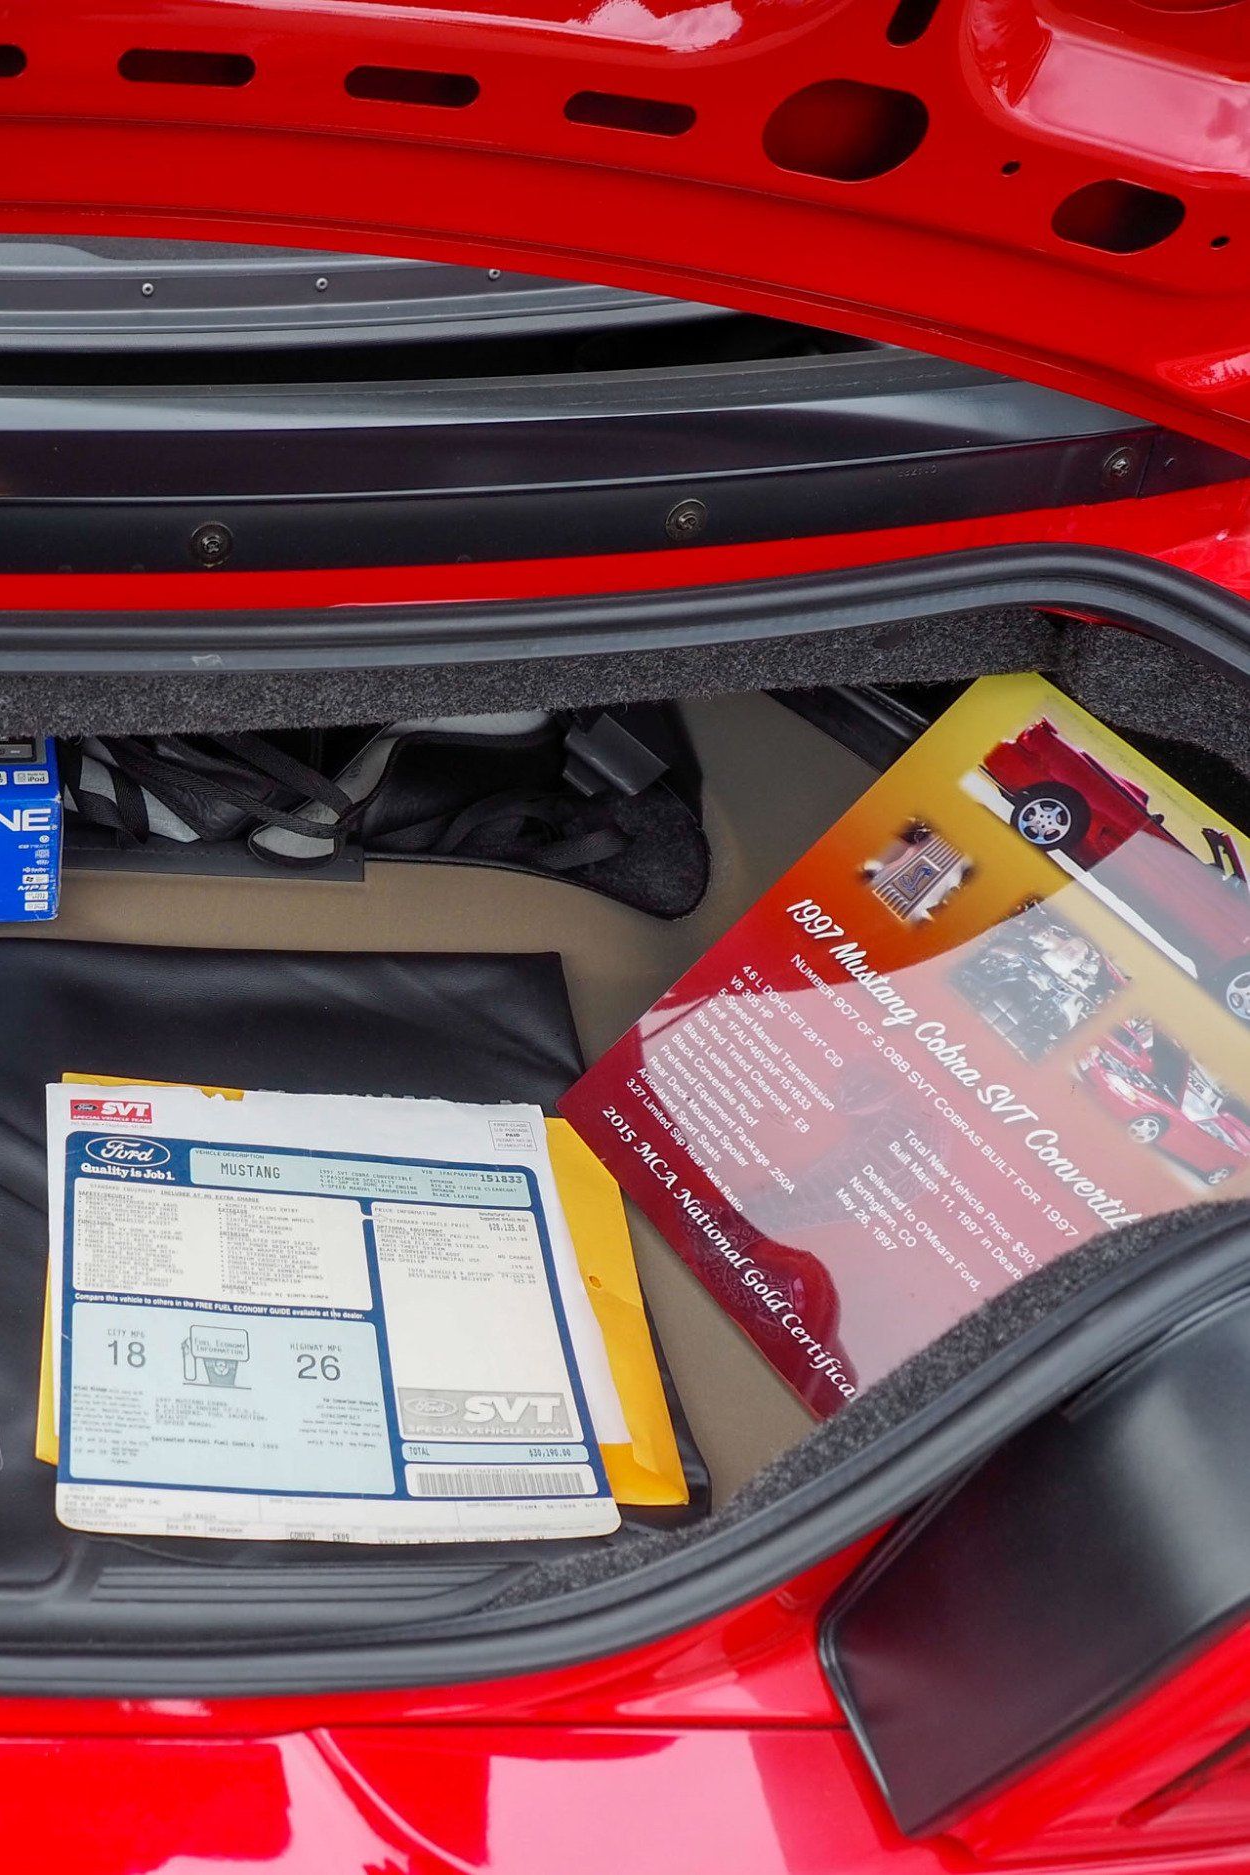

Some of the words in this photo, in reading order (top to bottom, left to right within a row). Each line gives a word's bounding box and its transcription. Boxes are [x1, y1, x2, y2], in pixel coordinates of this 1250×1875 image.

[706, 998, 728, 1021] Vin#
[730, 974, 745, 991] V8
[741, 988, 762, 1008] 305
[758, 1004, 774, 1019] HP
[742, 965, 759, 981] 4.6
[754, 977, 764, 989] L
[761, 983, 791, 1014] DOHC
[787, 1010, 807, 1030] EFI
[824, 1048, 844, 1068] CID
[785, 899, 845, 940] 1997
[828, 942, 913, 1025] Mustang
[914, 1021, 982, 1088] Cobra
[976, 1084, 1039, 1124] SVT
[671, 1032, 695, 1060] Black
[693, 1057, 737, 1106] Convertible
[735, 1102, 760, 1128] Roof
[682, 1021, 708, 1050] Black
[704, 1045, 737, 1080] Leather
[734, 1077, 764, 1110] Interior
[694, 1009, 710, 1028] Rio
[707, 1024, 729, 1046] Red
[726, 1041, 754, 1073] Tinted
[750, 1069, 792, 1115] Clearcoat
[793, 1116, 811, 1134] E8
[717, 987, 755, 1026] 5-Speed
[750, 1021, 784, 1055] Manual
[780, 1051, 835, 1112] Transmission
[100, 1102, 150, 1118] SVT
[636, 1067, 679, 1113] Articulated
[676, 1110, 700, 1137] Sport
[696, 1133, 722, 1163] Seats
[648, 1055, 670, 1078] Rear
[666, 1075, 689, 1101] Deck
[686, 1098, 724, 1138] Mounted
[719, 1134, 750, 1168] Spoiler
[660, 1044, 699, 1086] Preferred
[693, 1081, 737, 1130] Equipment
[732, 1125, 771, 1168] Package
[790, 953, 836, 999] NUMBER
[832, 996, 860, 1020] 907
[906, 1070, 938, 1098] SVT
[933, 1096, 984, 1147] COBRAS
[980, 1144, 1018, 1178] BUILT
[1012, 1176, 1042, 1205] FOR
[1041, 1203, 1079, 1237] 1997
[80, 1162, 129, 1179] Quality
[129, 1169, 142, 1178] is
[143, 1169, 165, 1180] Job
[100, 1140, 154, 1162] Ford
[220, 1162, 281, 1179] MUSTANG
[626, 1077, 647, 1098] 3.27
[642, 1096, 674, 1130] Limited
[669, 1127, 686, 1147] Slip
[683, 1143, 706, 1168] Rear
[702, 1166, 723, 1188] Axle
[720, 1184, 744, 1212] Ratio
[480, 1174, 523, 1184] 151833
[602, 1105, 638, 1143] 2015
[633, 1141, 679, 1190] MCA
[673, 1188, 755, 1270] National
[740, 1269, 793, 1314] Gold
[848, 1175, 898, 1232] Northglenn,
[898, 1228, 917, 1248] CO
[888, 1140, 912, 1166] Built
[908, 1161, 940, 1195] March
[940, 1194, 956, 1213] 11,
[956, 1210, 984, 1236] 1997
[980, 1235, 993, 1250] in
[904, 1128, 932, 1158] Total
[925, 1153, 952, 1179] New
[949, 1175, 985, 1215] Vehicle
[983, 1211, 1014, 1244] Price:
[835, 1187, 858, 1211] May
[854, 1208, 872, 1229] 26,
[872, 1226, 898, 1251] 1997
[861, 1164, 909, 1211] Delivered
[903, 1208, 916, 1222] to
[915, 1220, 956, 1265] O'Meara
[954, 1261, 981, 1292] Ford,
[74, 1292, 104, 1302] Compare
[106, 1294, 118, 1302] this
[183, 1300, 194, 1308] the
[194, 1301, 213, 1310] FREE
[214, 1303, 232, 1311] FUEL
[233, 1304, 268, 1314] ECONOMY
[269, 1307, 291, 1315] GUIDE
[107, 1329, 128, 1337] CITY
[107, 1340, 147, 1368] 18
[289, 1343, 323, 1352] HIGHWAY
[326, 1344, 342, 1352] MPG
[296, 1354, 341, 1382] 26
[409, 1425, 464, 1435] SPECIAL
[467, 1426, 523, 1435] VEHICLE
[528, 1427, 570, 1436] TEAM
[463, 1395, 561, 1423] SVT
[409, 1447, 430, 1456] TOTAL
